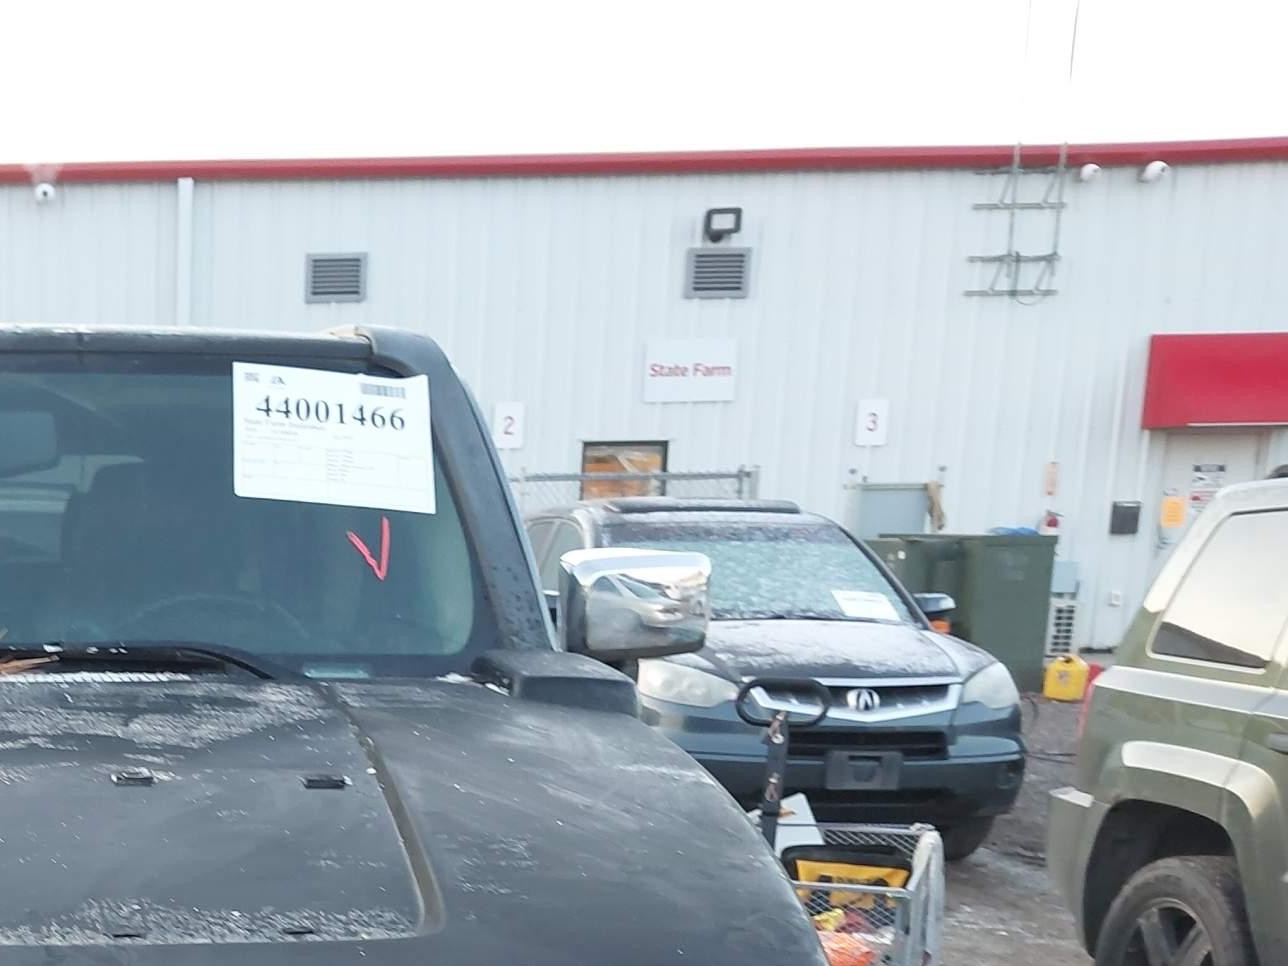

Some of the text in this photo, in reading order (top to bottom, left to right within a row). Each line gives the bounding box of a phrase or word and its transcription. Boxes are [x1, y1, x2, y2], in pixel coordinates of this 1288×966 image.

[649, 363, 732, 377] State Farm
[256, 395, 406, 430] 44001466
[865, 412, 879, 432] 3
[504, 415, 515, 436] 2
